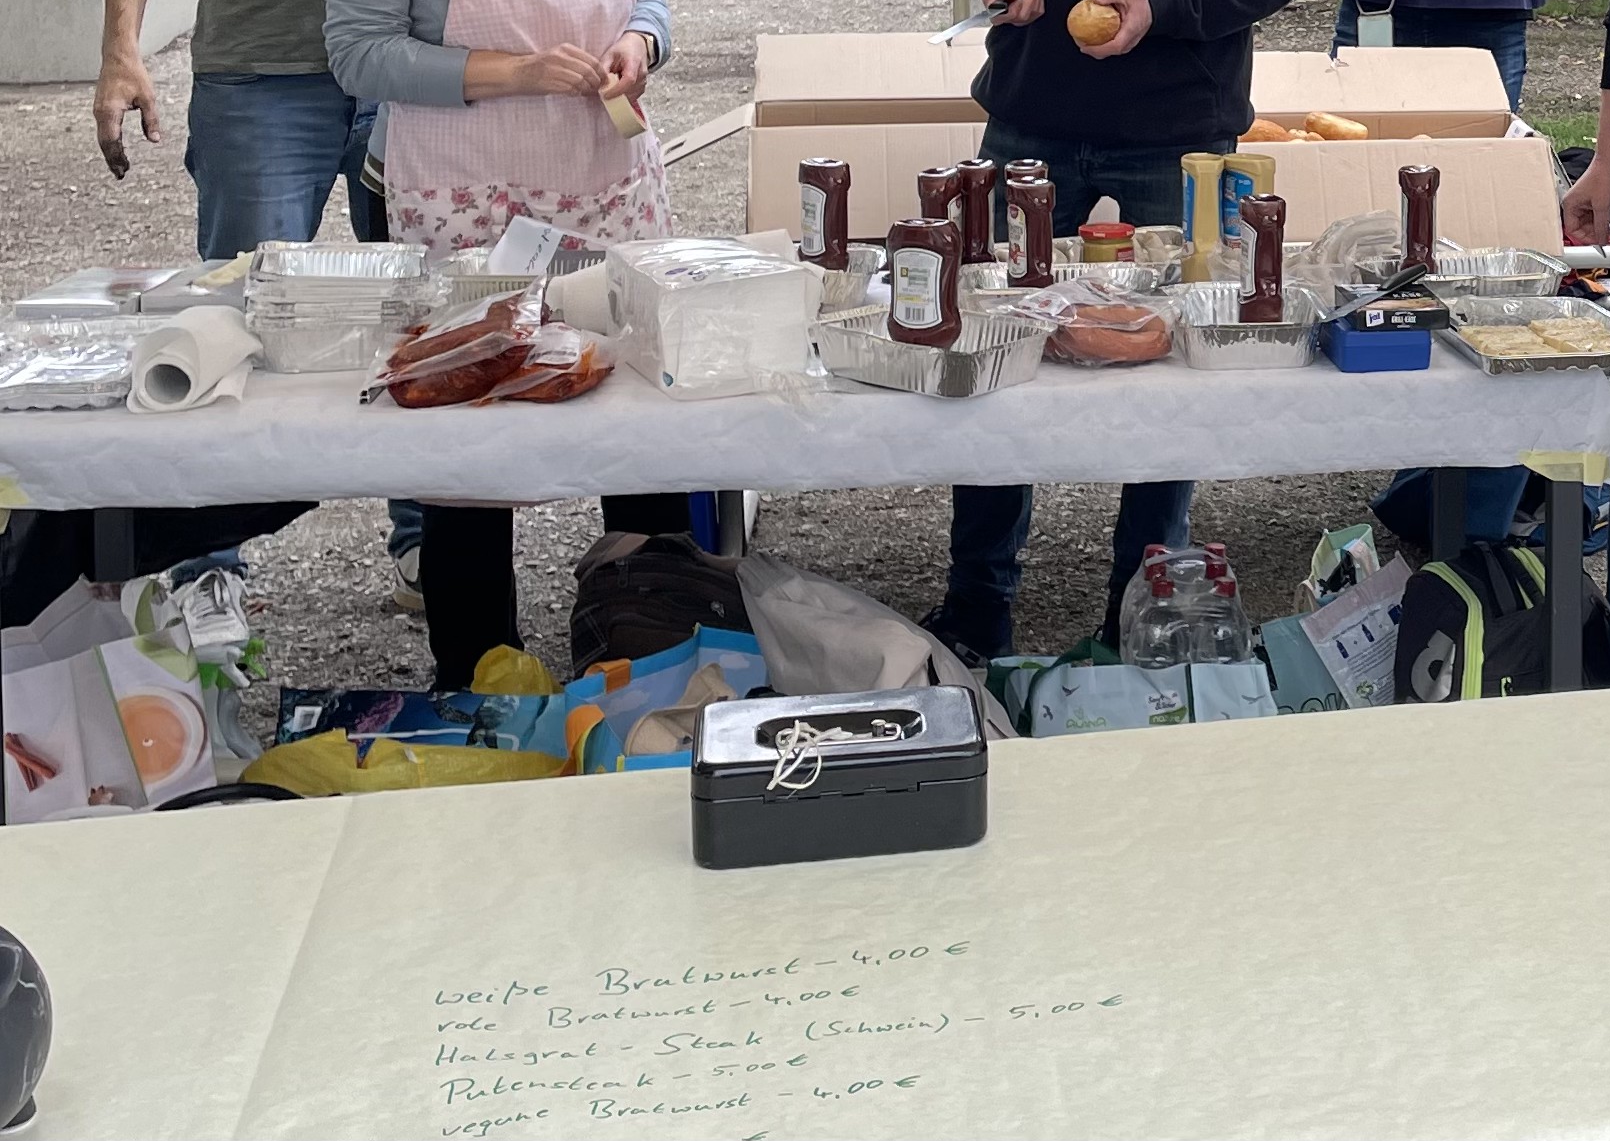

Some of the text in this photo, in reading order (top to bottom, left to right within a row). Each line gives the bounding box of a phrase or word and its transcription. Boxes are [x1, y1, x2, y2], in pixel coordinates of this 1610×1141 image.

[434, 980, 550, 1006] weiße
[595, 958, 800, 996] Bratwurst
[944, 941, 970, 955] €
[435, 1043, 598, 1067] Halsgrat
[654, 1030, 763, 1056] Steak
[805, 1013, 950, 1041] (Schwein)
[1097, 994, 1122, 1007] €
[437, 1016, 498, 1033] rote
[548, 999, 716, 1028] Bratwurst
[840, 985, 860, 997] €
[439, 1073, 655, 1105] Putensteak
[786, 1053, 808, 1067] €
[442, 1109, 550, 1138] vegane
[589, 1092, 752, 1119] Bratwurst
[892, 1075, 921, 1089] €
